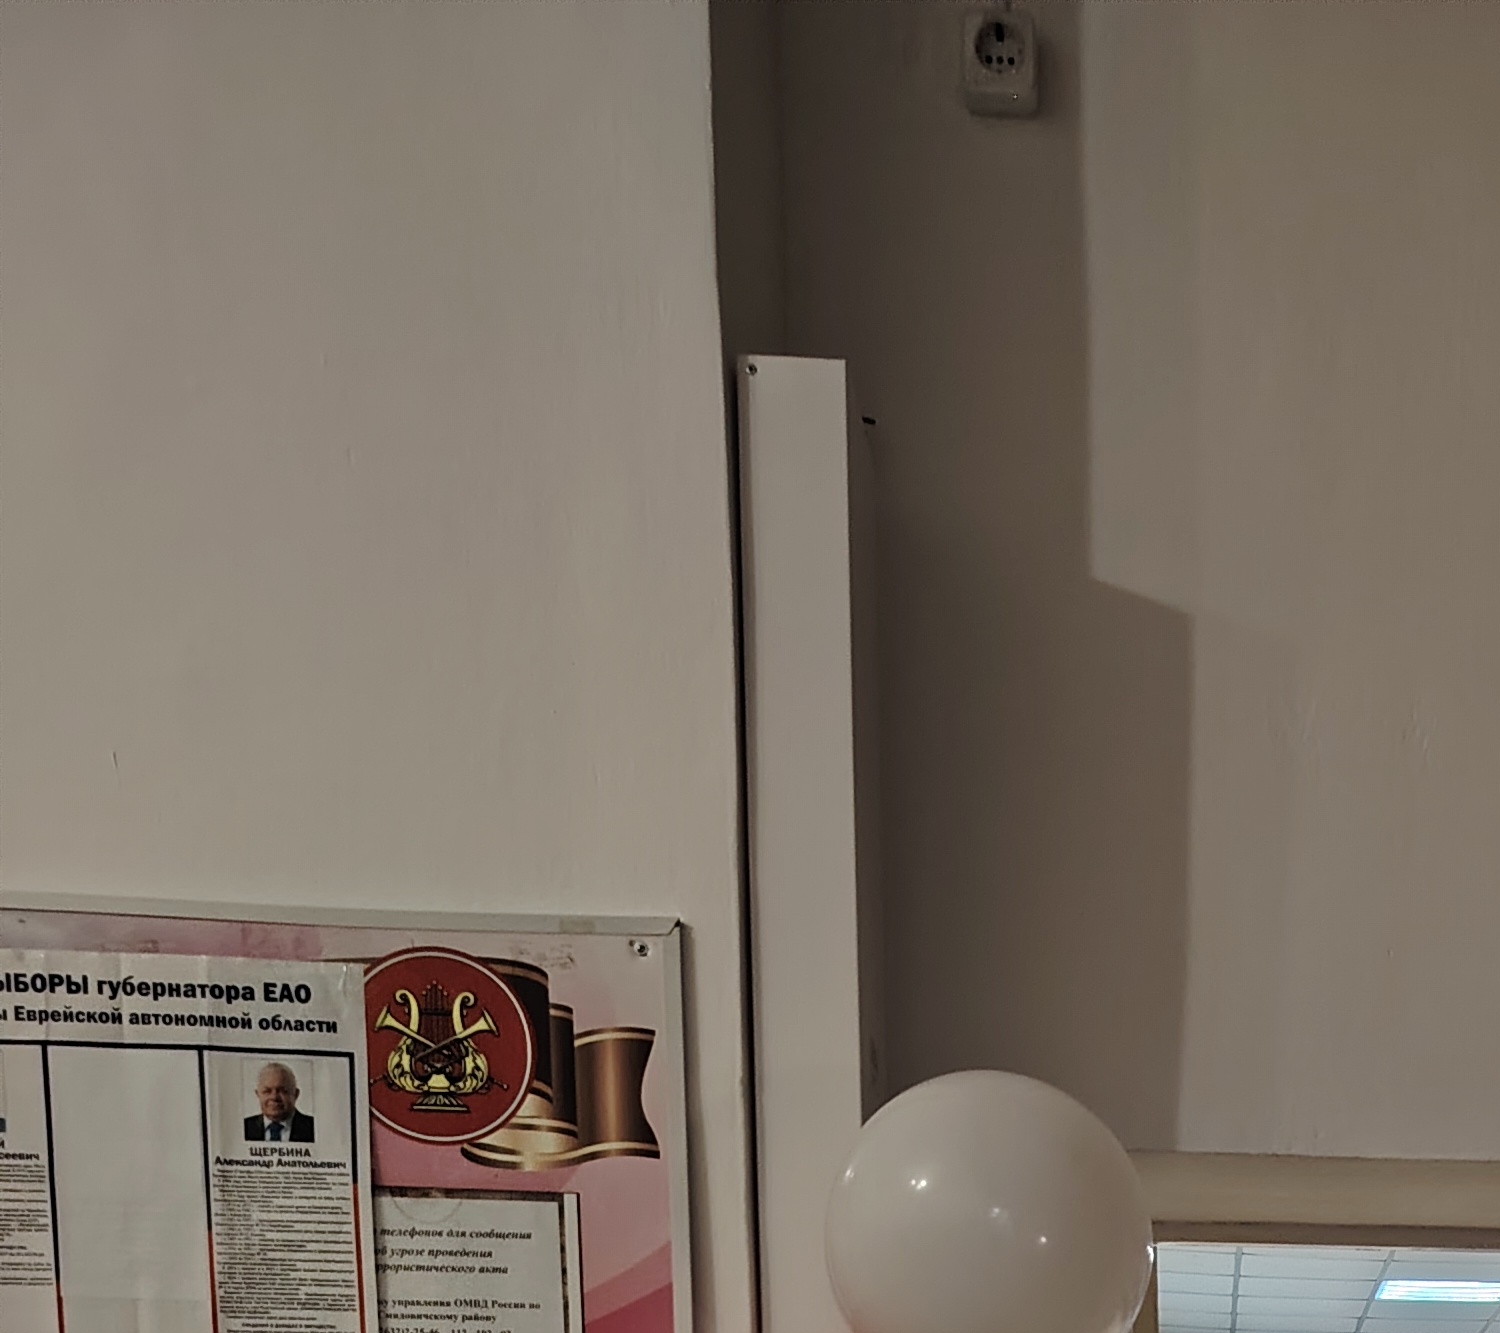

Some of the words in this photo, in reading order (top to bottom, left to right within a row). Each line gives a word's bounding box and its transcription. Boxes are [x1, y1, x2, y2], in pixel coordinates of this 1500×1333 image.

[97, 976, 255, 1005] губернатора
[263, 982, 312, 1004] ЕАО
[14, 1006, 123, 1025] Еврейской
[129, 1009, 251, 1030] автономной
[258, 1014, 338, 1033] области
[250, 1147, 311, 1157] ЩЕРБИНА
[215, 1156, 274, 1168] Александр
[277, 1158, 347, 1169] Анатольевич
[380, 1226, 443, 1241] телефонов
[447, 1227, 467, 1239] для
[469, 1228, 532, 1240] сообщения
[390, 1248, 425, 1259] угрозе
[428, 1247, 493, 1259] проведения
[479, 1266, 508, 1274] акта
[391, 1299, 451, 1309] управления
[454, 1299, 489, 1309] ОМВД
[491, 1300, 526, 1309] России
[462, 1313, 496, 1324] району
